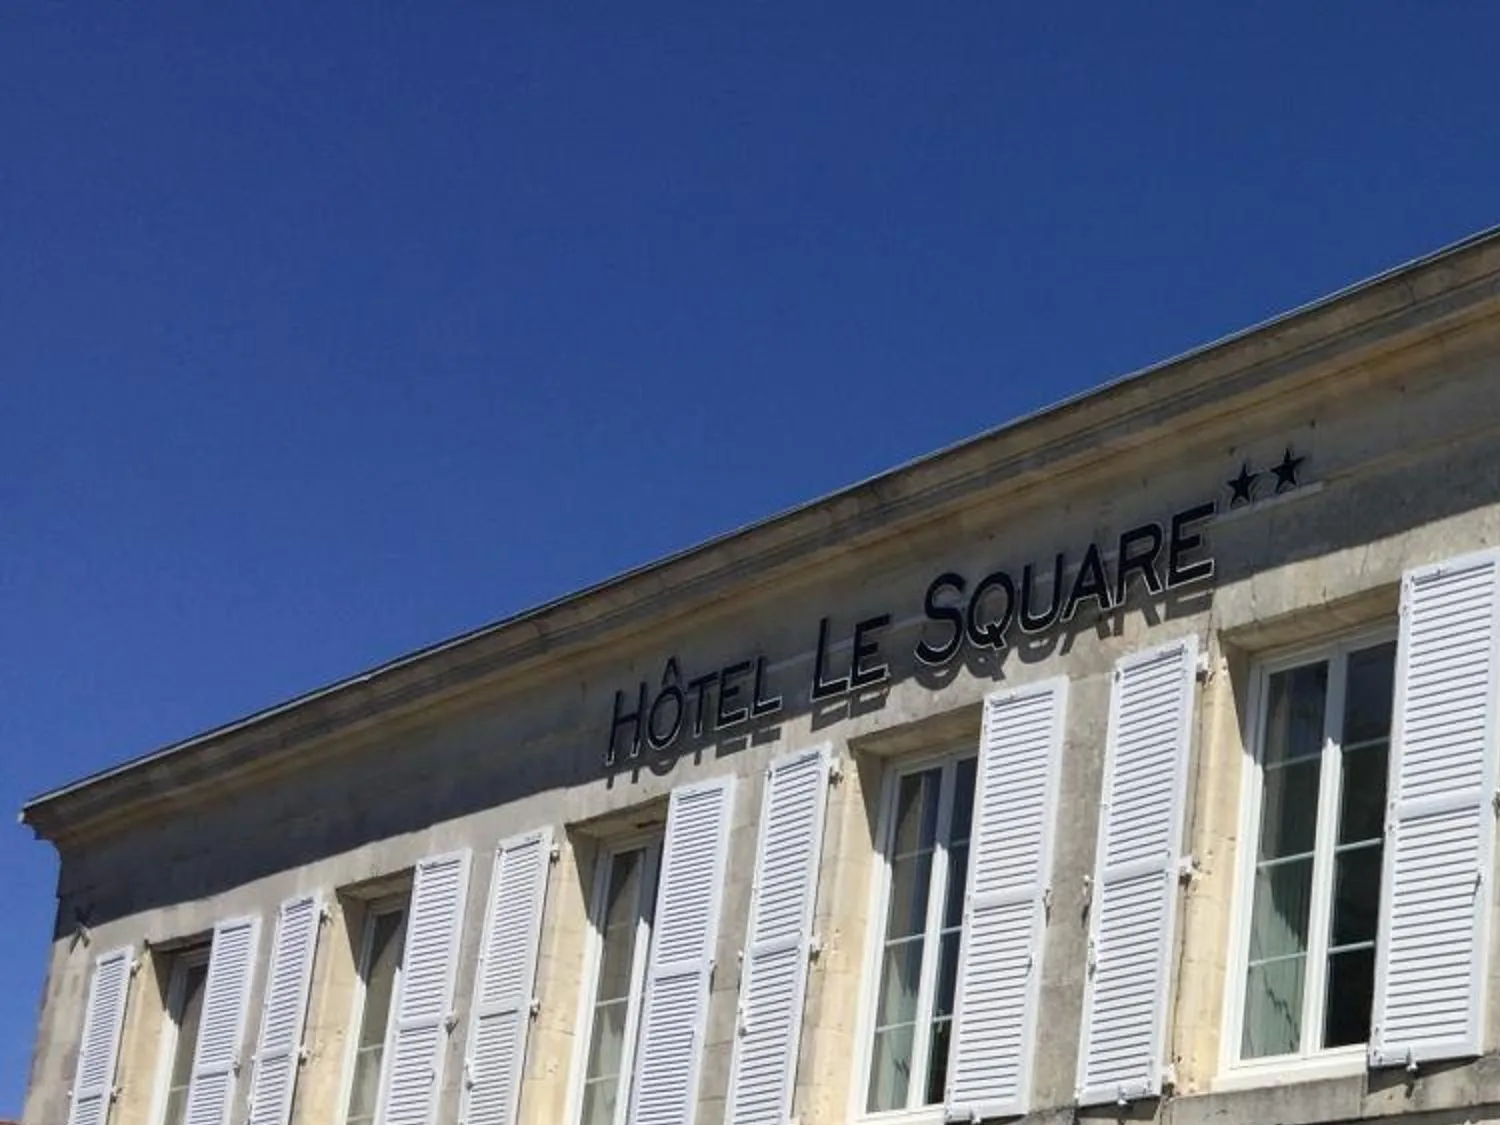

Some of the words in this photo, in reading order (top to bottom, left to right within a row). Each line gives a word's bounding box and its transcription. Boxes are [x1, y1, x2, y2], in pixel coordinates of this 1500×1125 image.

[604, 656, 783, 766] HÔTEL
[810, 614, 892, 702] LE
[913, 502, 1217, 667] SQUARE
